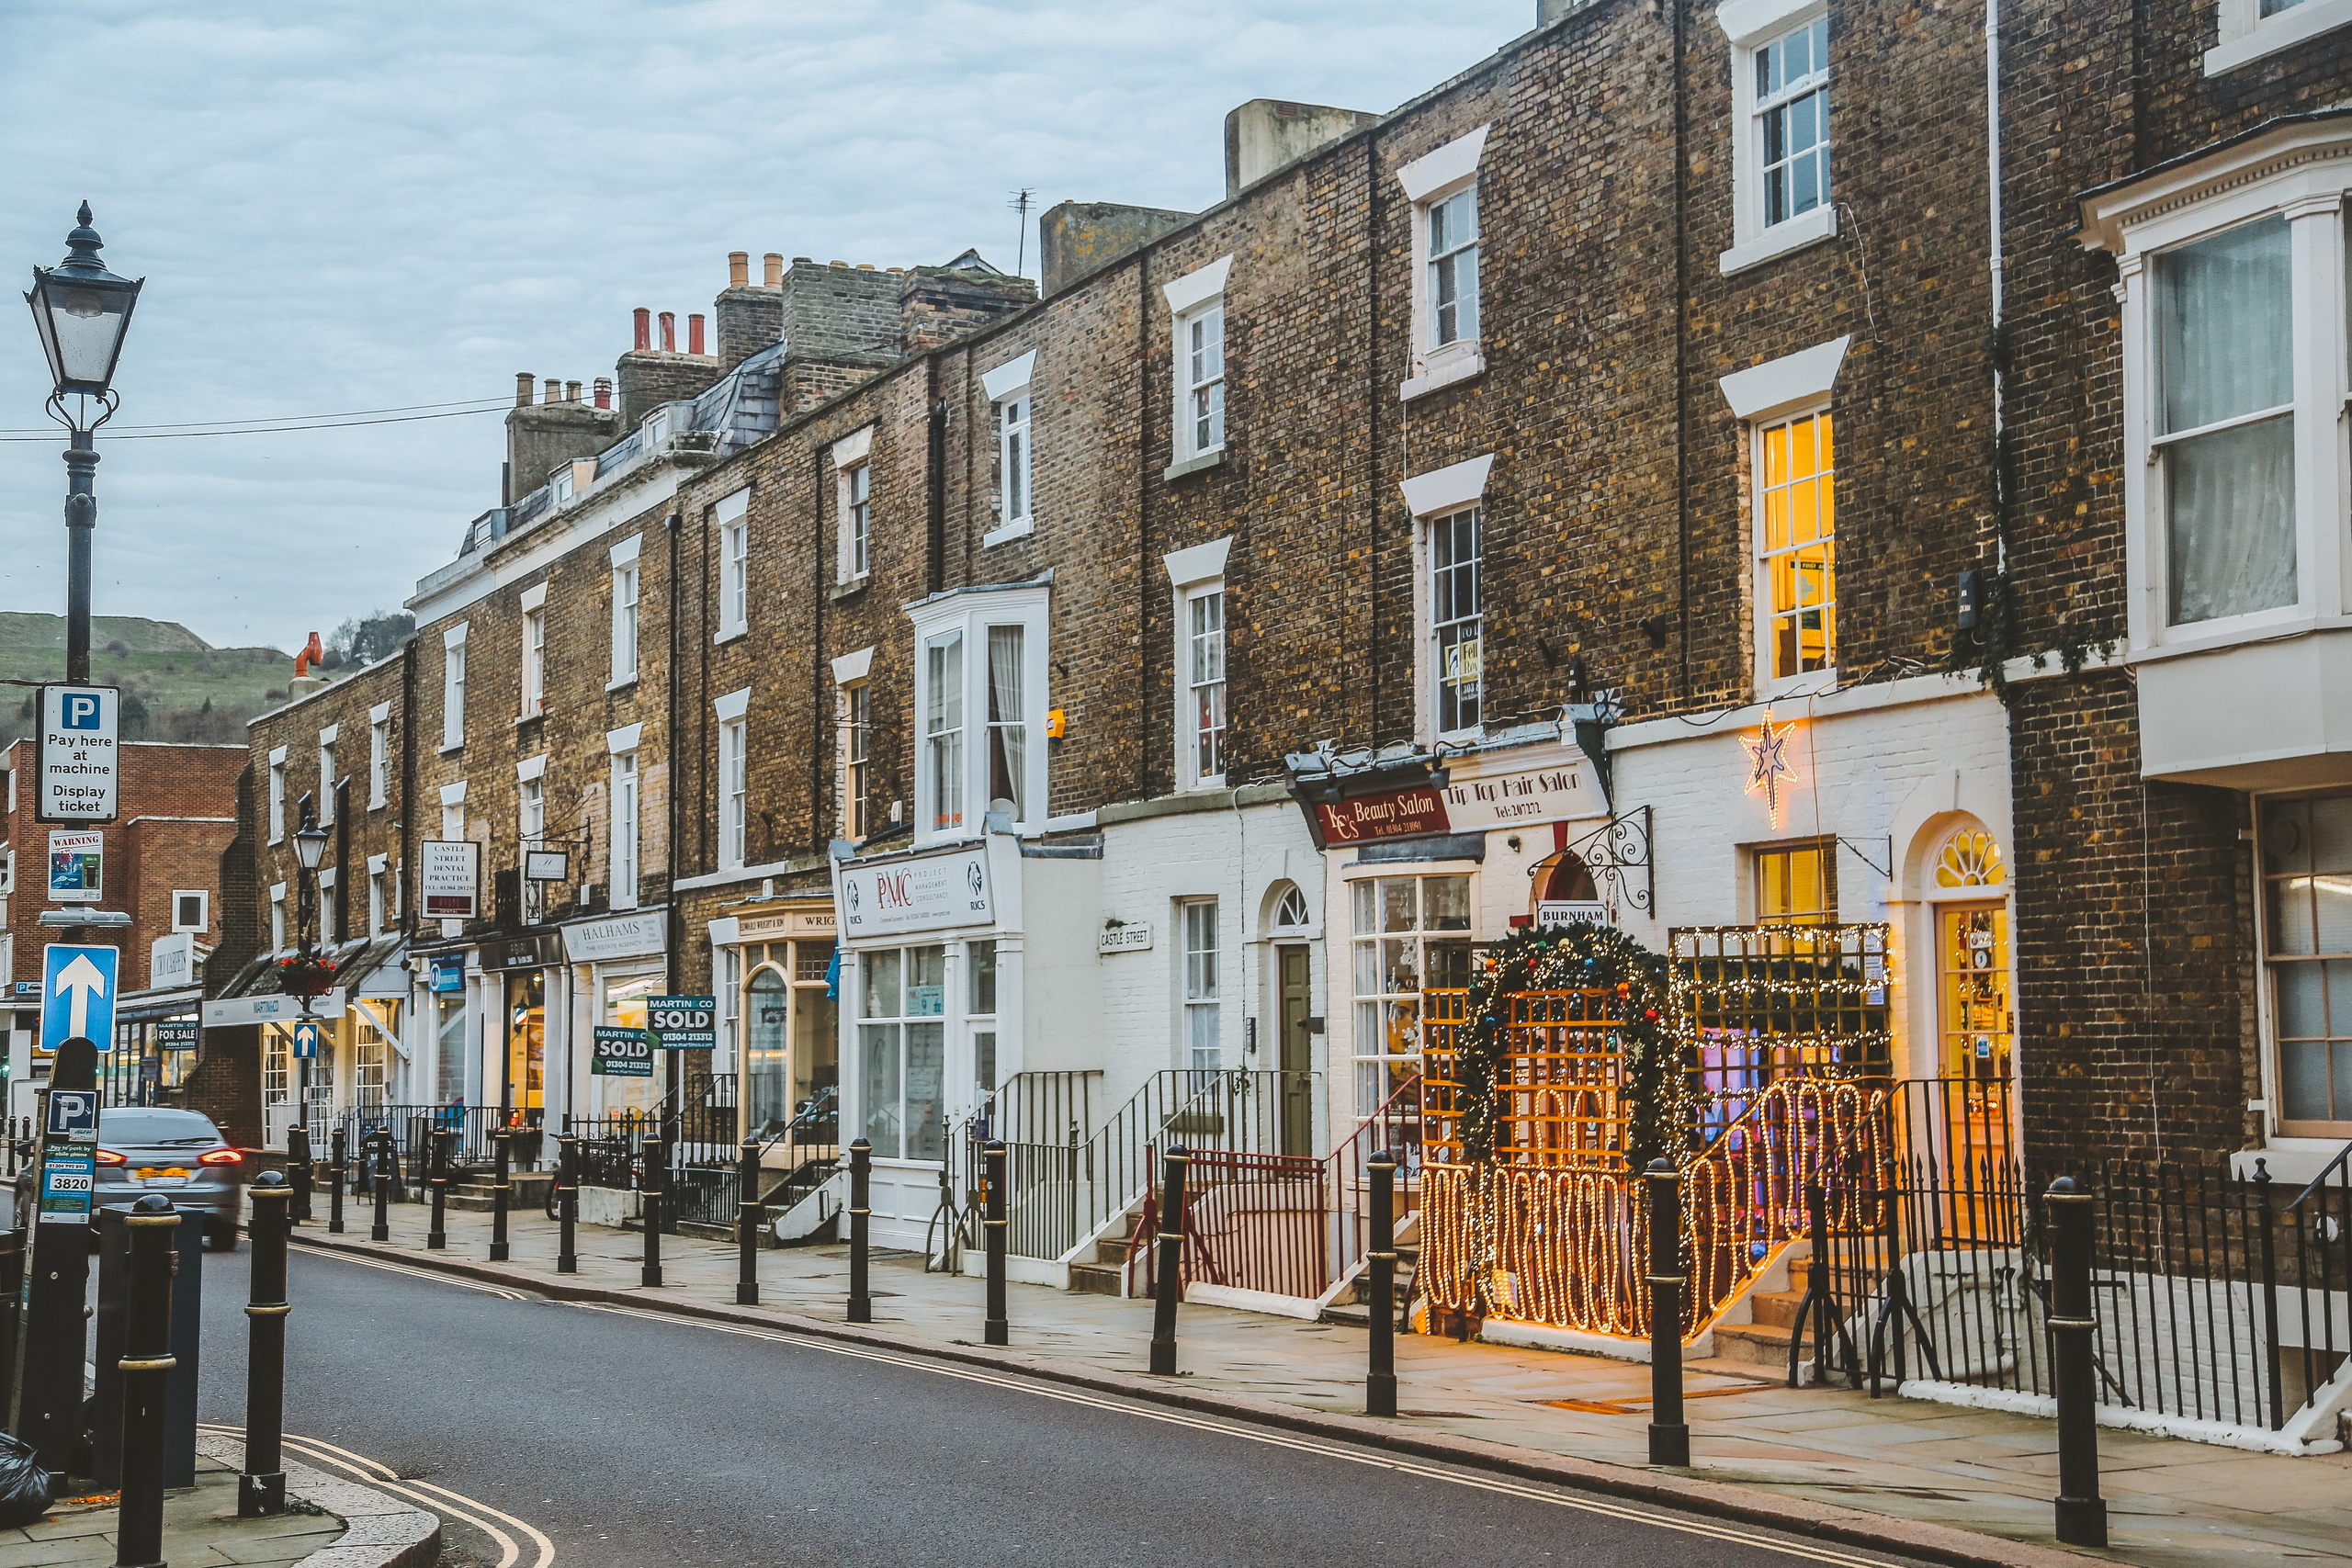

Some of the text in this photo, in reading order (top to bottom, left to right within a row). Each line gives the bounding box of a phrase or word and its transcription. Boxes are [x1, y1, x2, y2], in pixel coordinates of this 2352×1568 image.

[71, 697, 96, 727] P
[48, 734, 112, 748] Pay here
[73, 750, 88, 761] at
[50, 763, 110, 774] machine
[52, 784, 106, 799] Display
[1448, 771, 1581, 806] Tip Top Hair Salon
[58, 800, 100, 812] ticket
[1353, 800, 1396, 823] Beauty
[1397, 793, 1434, 816] Salon
[53, 836, 99, 846] WARNING
[876, 867, 914, 909] PMC
[805, 917, 836, 926] WRIG
[1543, 911, 1603, 920] BURNHAM
[582, 921, 640, 940] HALHAMS
[1102, 931, 1148, 946] CASTLE STREET
[653, 1010, 709, 1028] SOLD
[159, 1030, 195, 1039] FOR SALE
[599, 1040, 648, 1057] SOLD
[605, 1060, 650, 1069] 01304 213312
[59, 1095, 85, 1129] P
[54, 1179, 88, 1190] 3820
